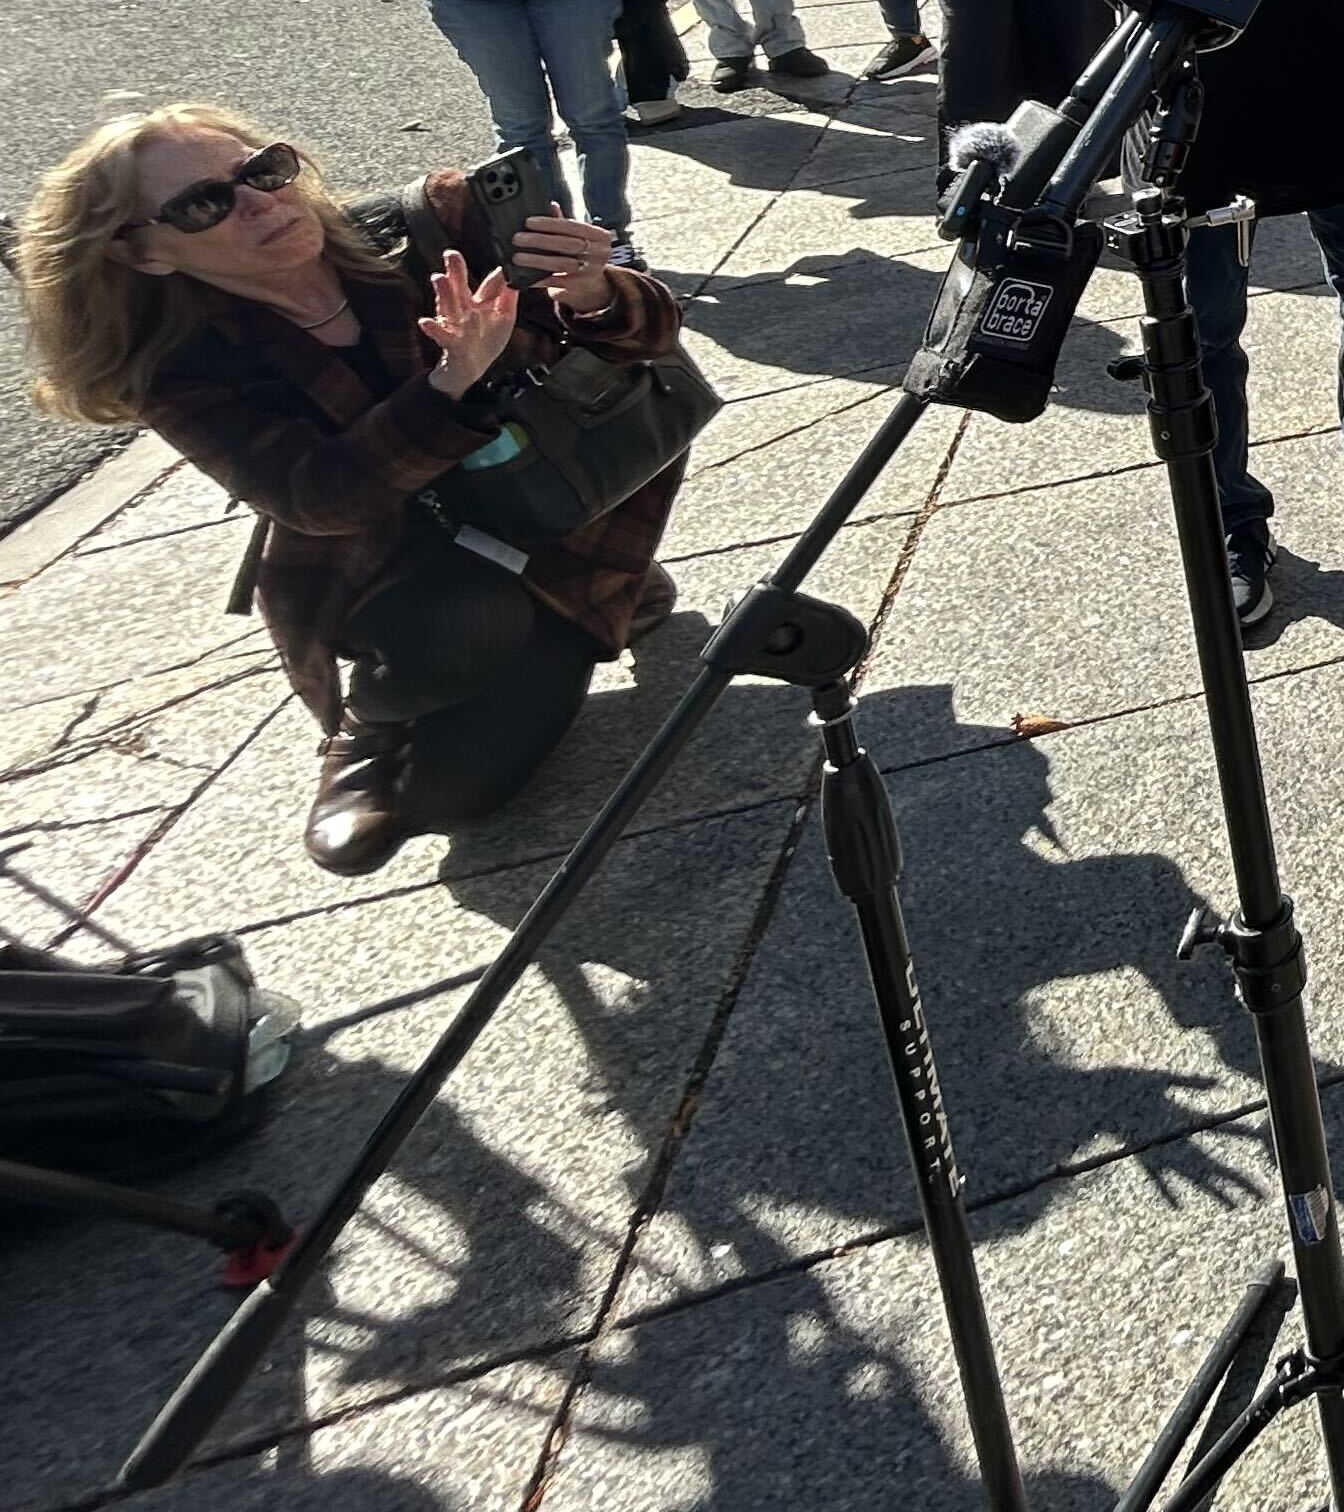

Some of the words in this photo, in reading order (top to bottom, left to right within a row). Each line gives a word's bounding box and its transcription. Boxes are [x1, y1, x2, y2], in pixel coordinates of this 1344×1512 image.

[994, 283, 1043, 317] porta
[987, 309, 1033, 336] brace
[900, 1019, 940, 1170] SUPPORT
